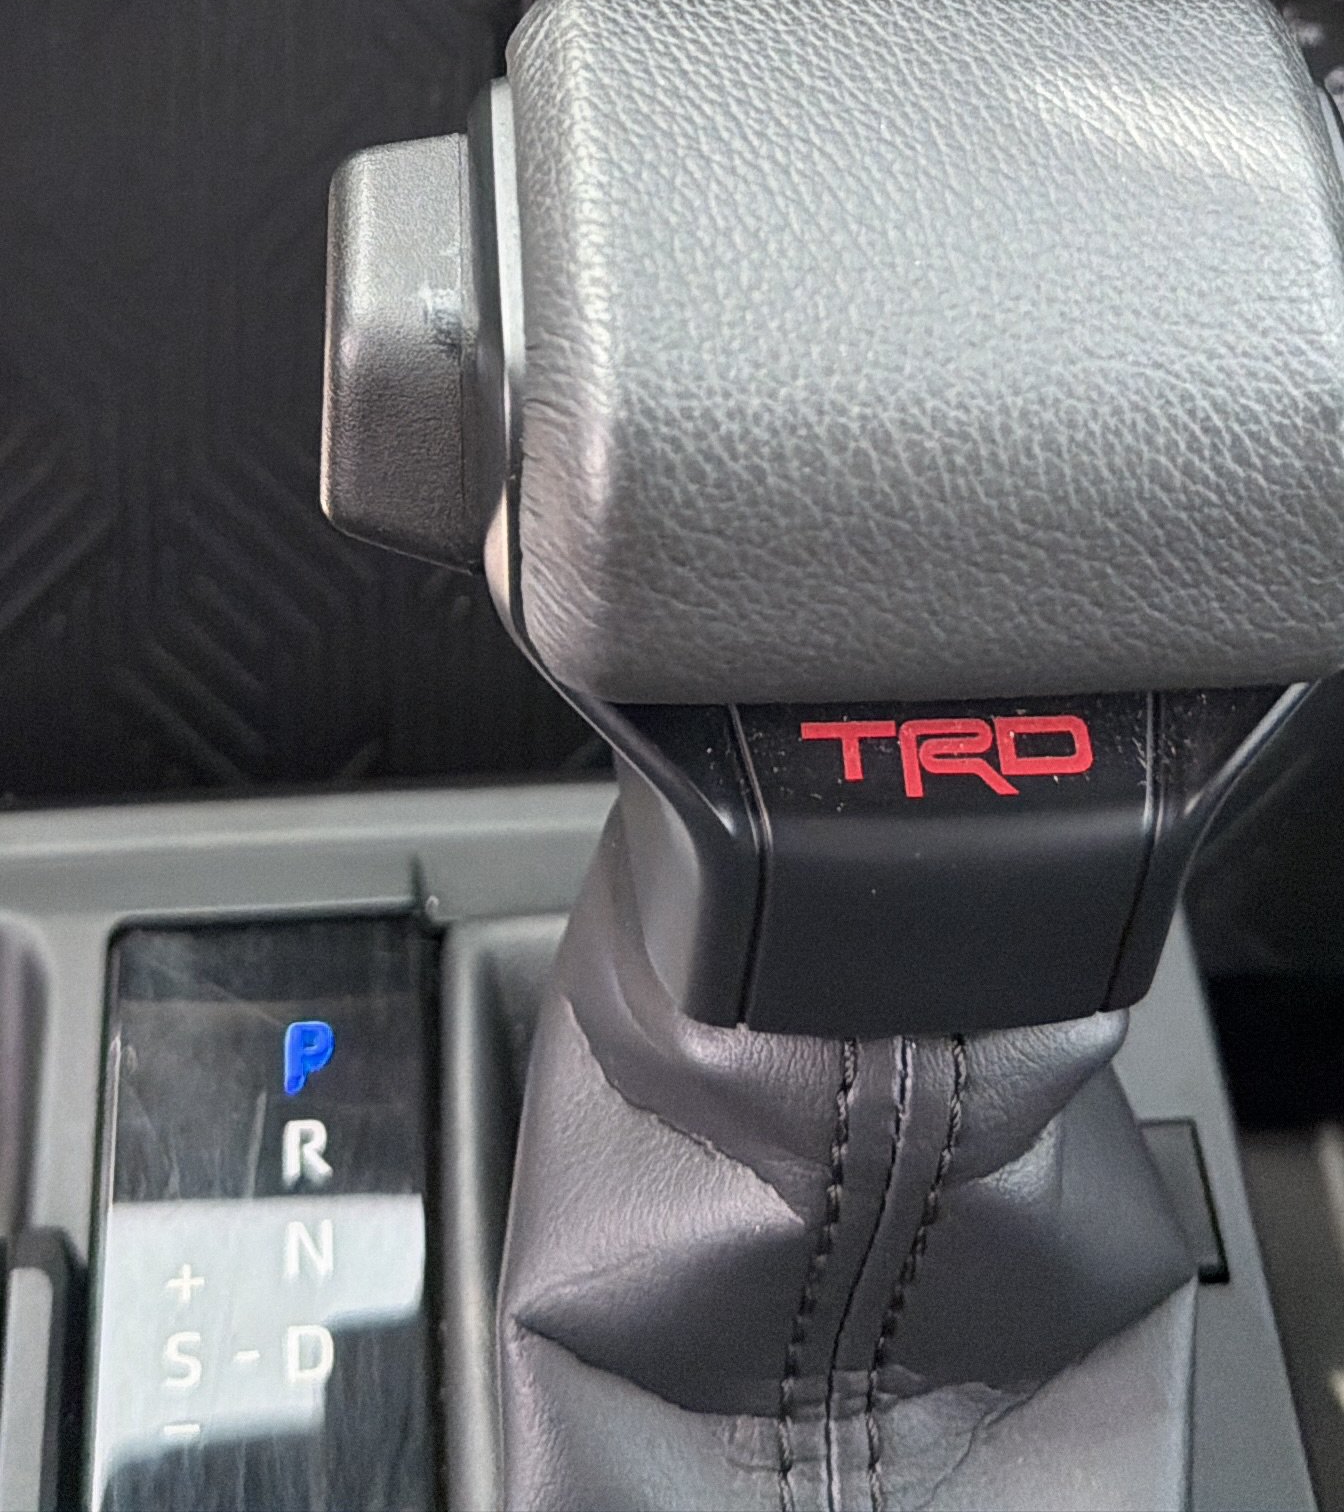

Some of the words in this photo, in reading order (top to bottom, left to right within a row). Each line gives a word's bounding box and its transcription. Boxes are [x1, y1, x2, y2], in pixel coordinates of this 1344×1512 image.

[799, 713, 1096, 801] TRD
[281, 1018, 338, 1099] P
[280, 1118, 336, 1187] R
[284, 1218, 336, 1281] N
[164, 1330, 202, 1390] S
[283, 1323, 336, 1387] D
